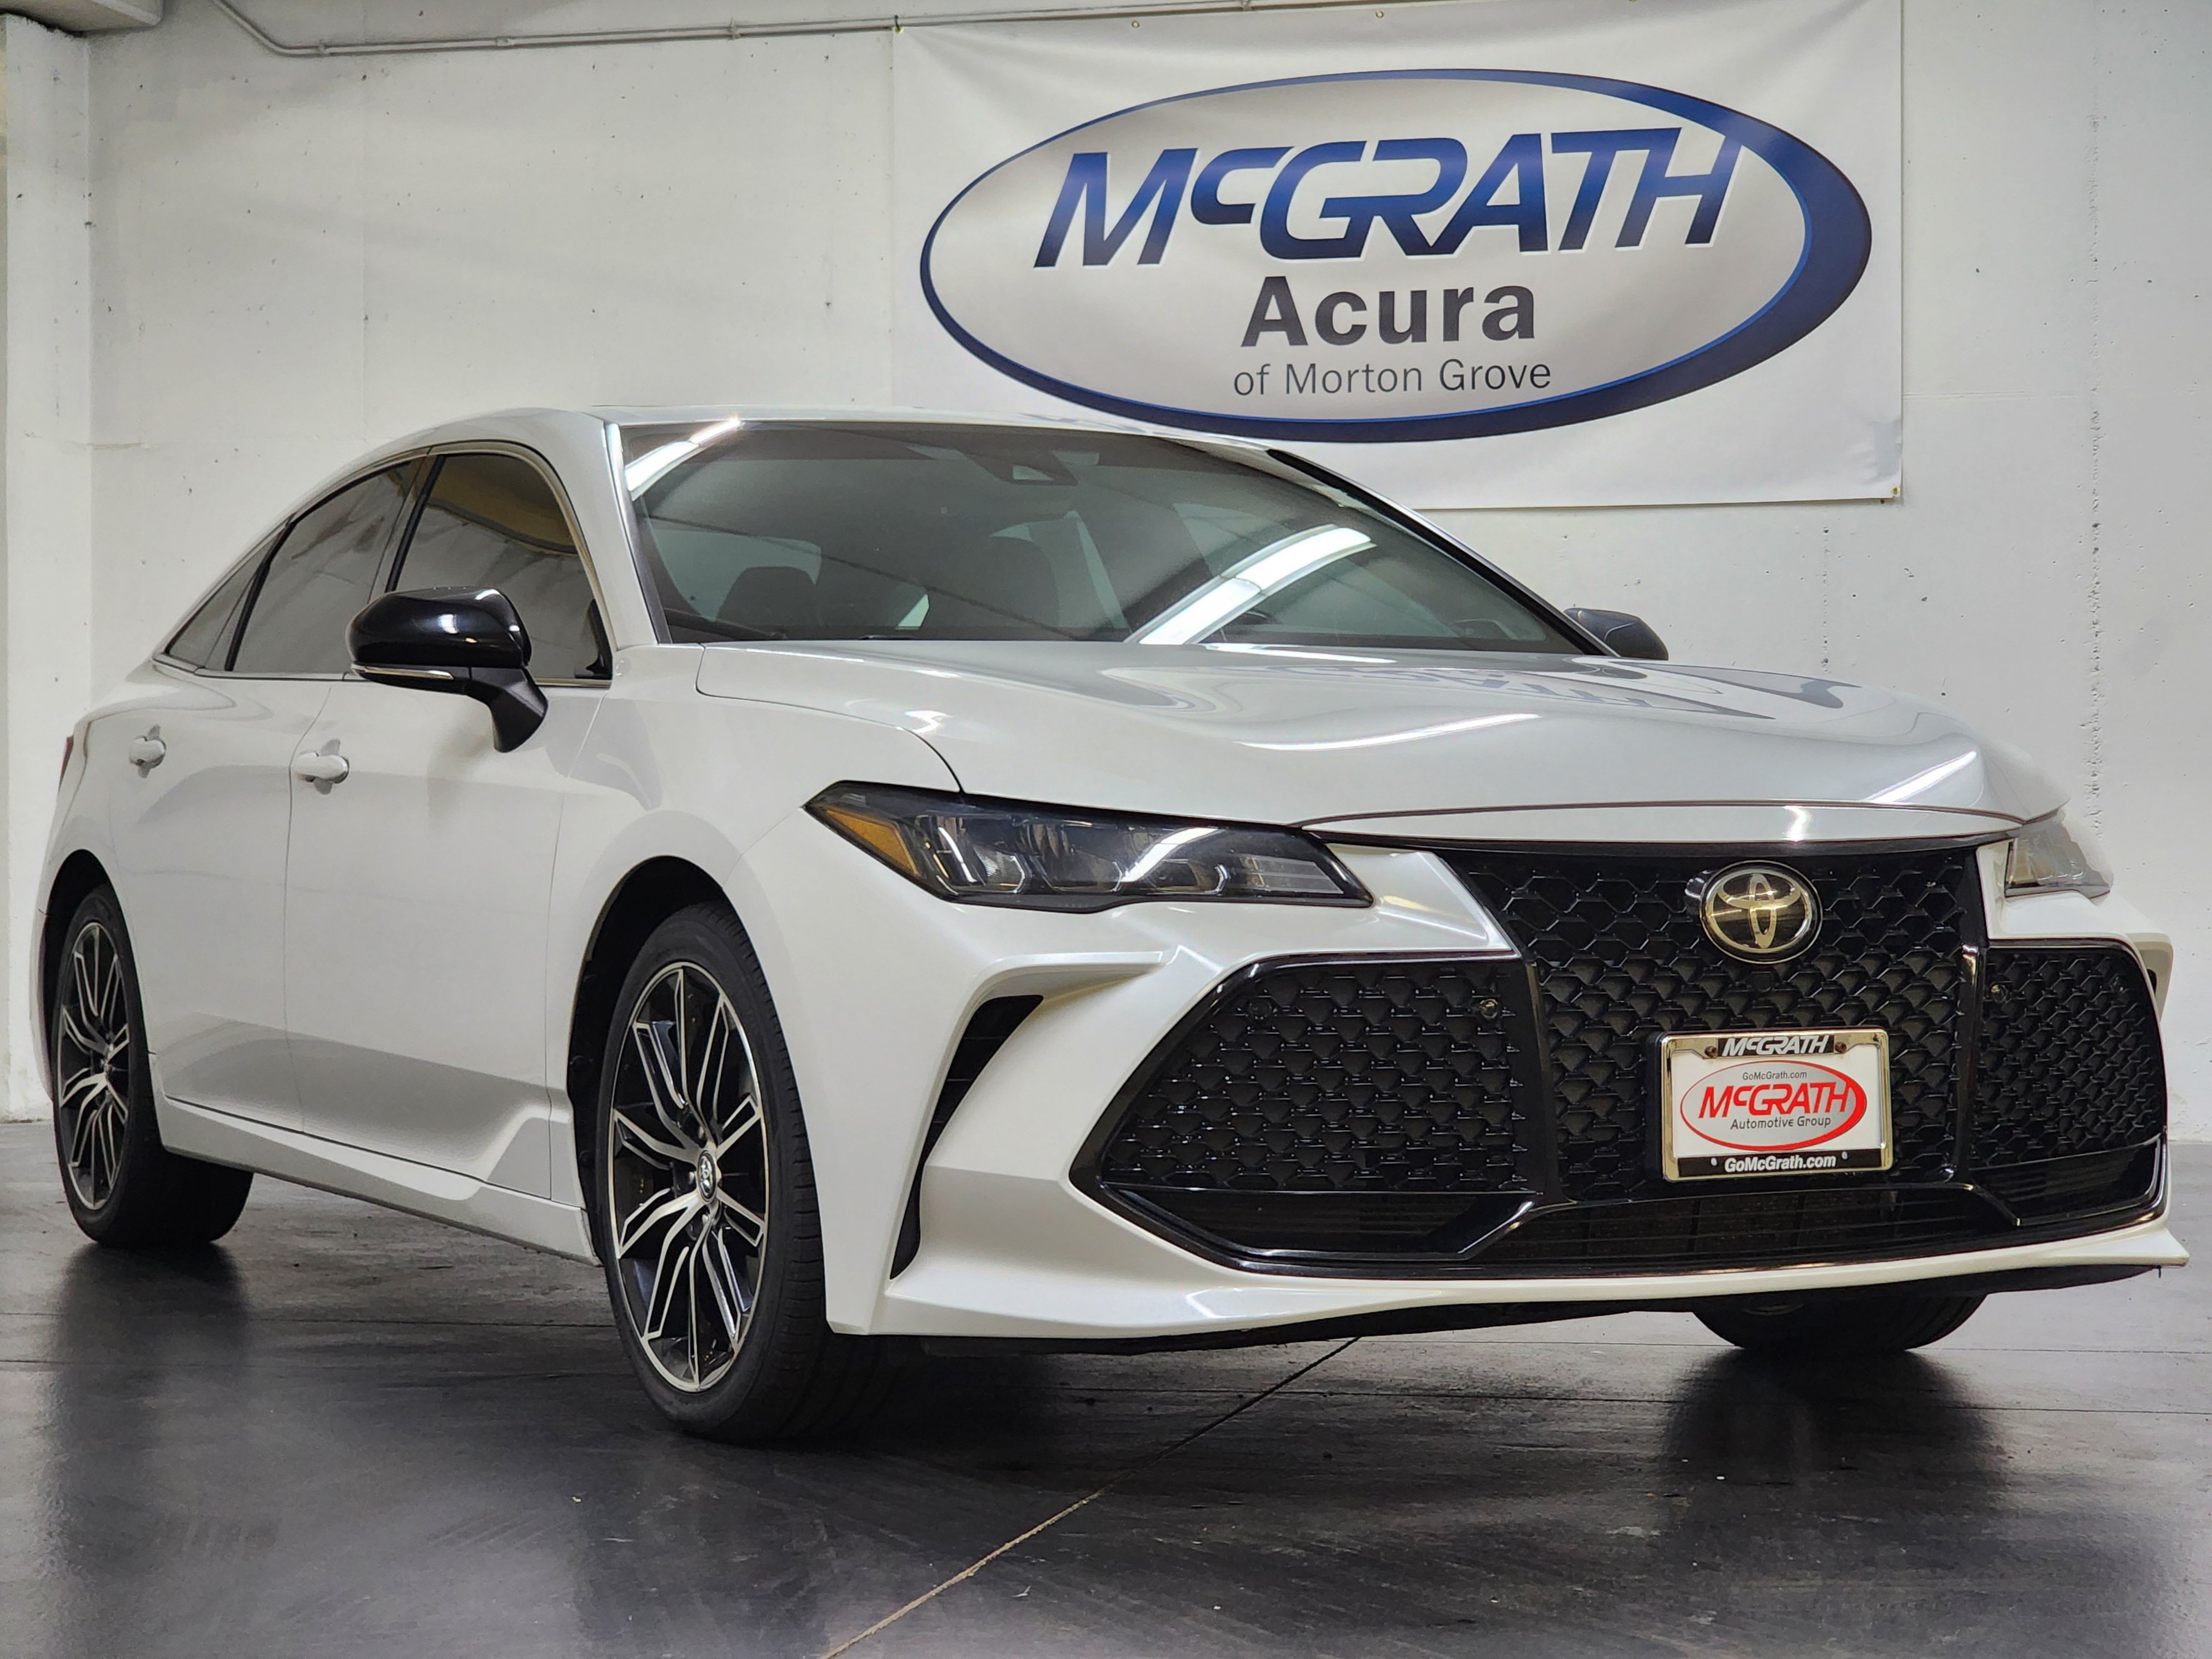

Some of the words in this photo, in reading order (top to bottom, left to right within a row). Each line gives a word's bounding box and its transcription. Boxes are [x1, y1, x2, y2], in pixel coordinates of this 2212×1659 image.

[1240, 276, 1535, 347] Acura
[1234, 363, 1271, 396] of
[1286, 363, 1422, 395] Morton
[1439, 358, 1551, 391] Grove
[1742, 1071, 1807, 1080] GoMcGrath.com
[1730, 1118, 1793, 1129] Automotive
[1797, 1115, 1831, 1128] Group
[1725, 1155, 1836, 1172] GoMcGrath.com
